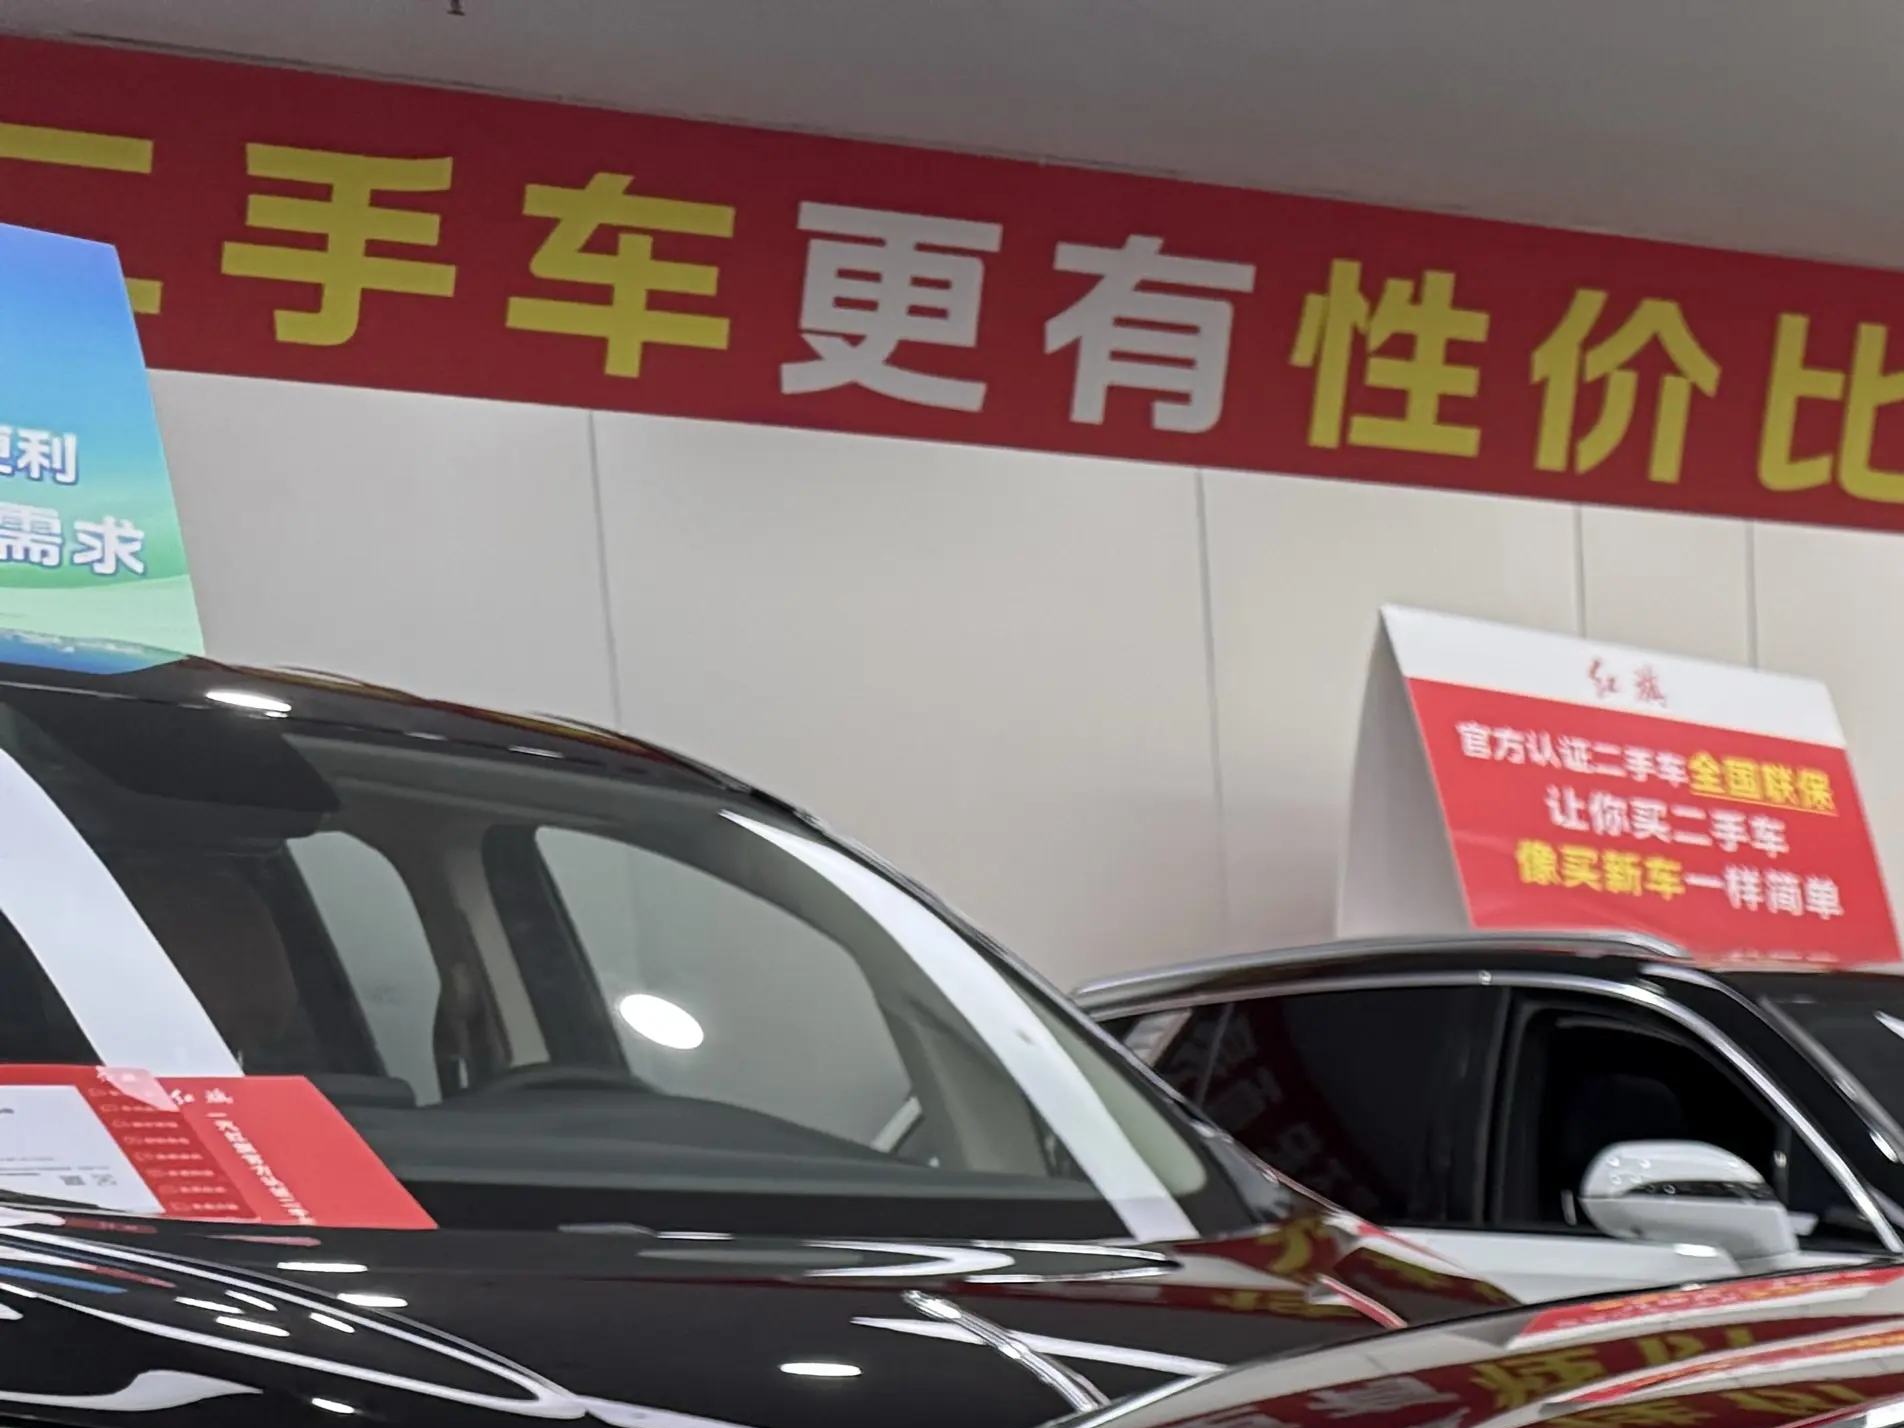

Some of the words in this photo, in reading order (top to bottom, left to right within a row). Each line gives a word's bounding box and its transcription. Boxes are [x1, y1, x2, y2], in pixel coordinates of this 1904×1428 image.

[0, 501, 146, 576] 需求
[1455, 720, 1836, 812] 官方认证二手车全国联保
[1545, 785, 1791, 859] 让你买二手车
[1515, 838, 1845, 921] 像买新车一样简单
